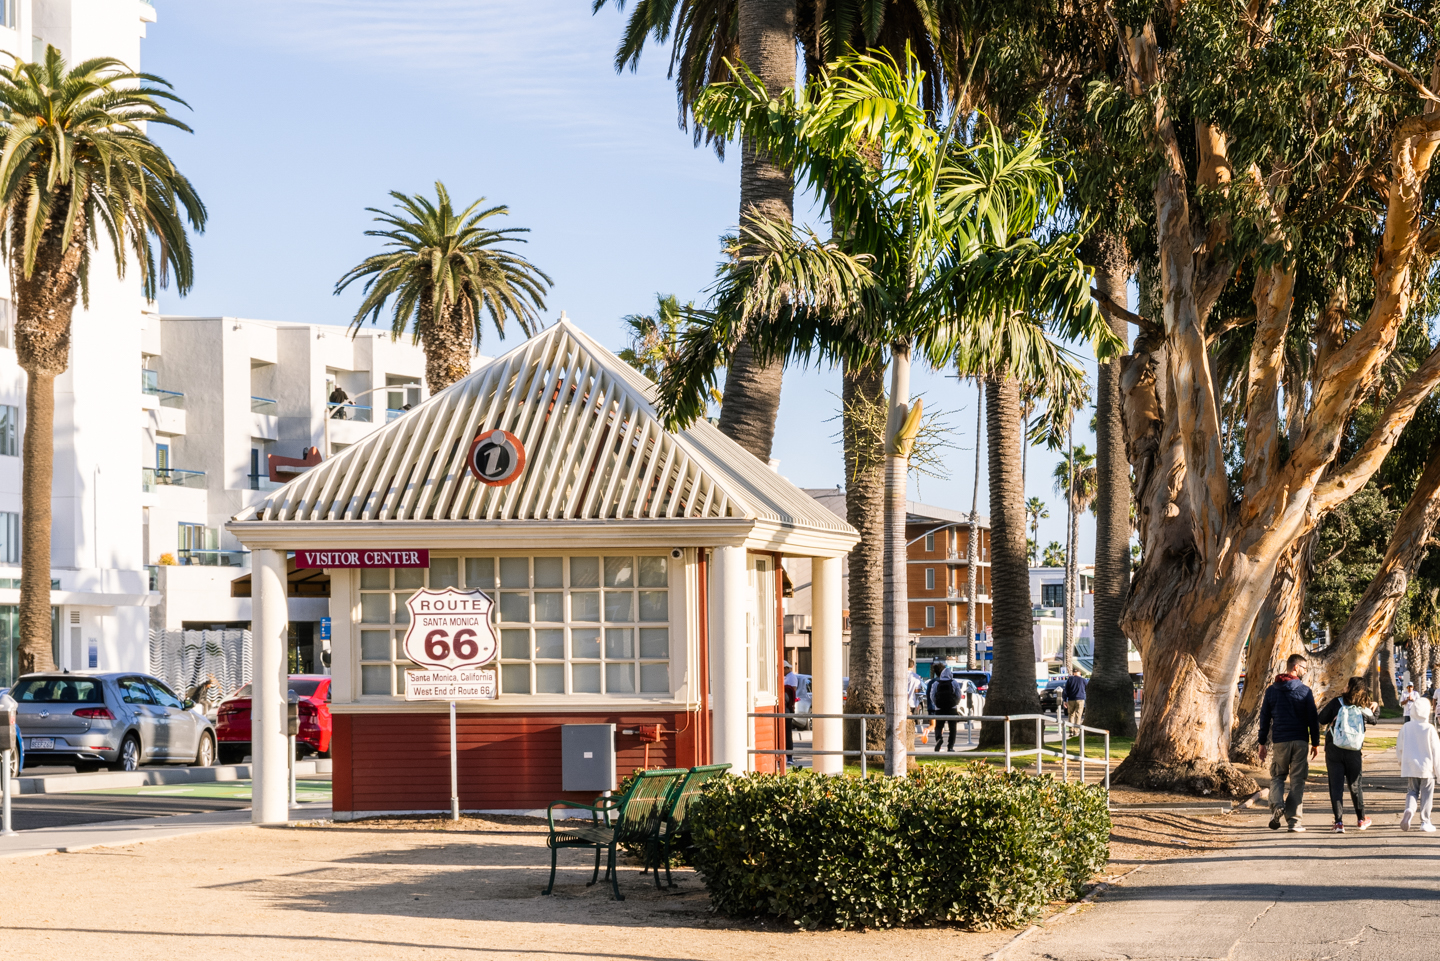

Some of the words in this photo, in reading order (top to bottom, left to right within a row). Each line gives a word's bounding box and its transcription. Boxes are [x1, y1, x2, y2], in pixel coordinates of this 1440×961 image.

[305, 551, 360, 565] VISITOR
[364, 551, 420, 565] CENTER
[420, 600, 482, 611] ROUTE
[423, 617, 448, 626] SANTA
[449, 617, 479, 626] MONICA
[424, 628, 479, 661] 66
[410, 673, 431, 682] Santa
[432, 673, 459, 682] Monica,
[460, 672, 493, 681] California
[413, 687, 433, 696] West
[434, 686, 447, 695] End
[449, 686, 457, 695] of
[458, 686, 479, 695] Route
[480, 686, 490, 695] 66
